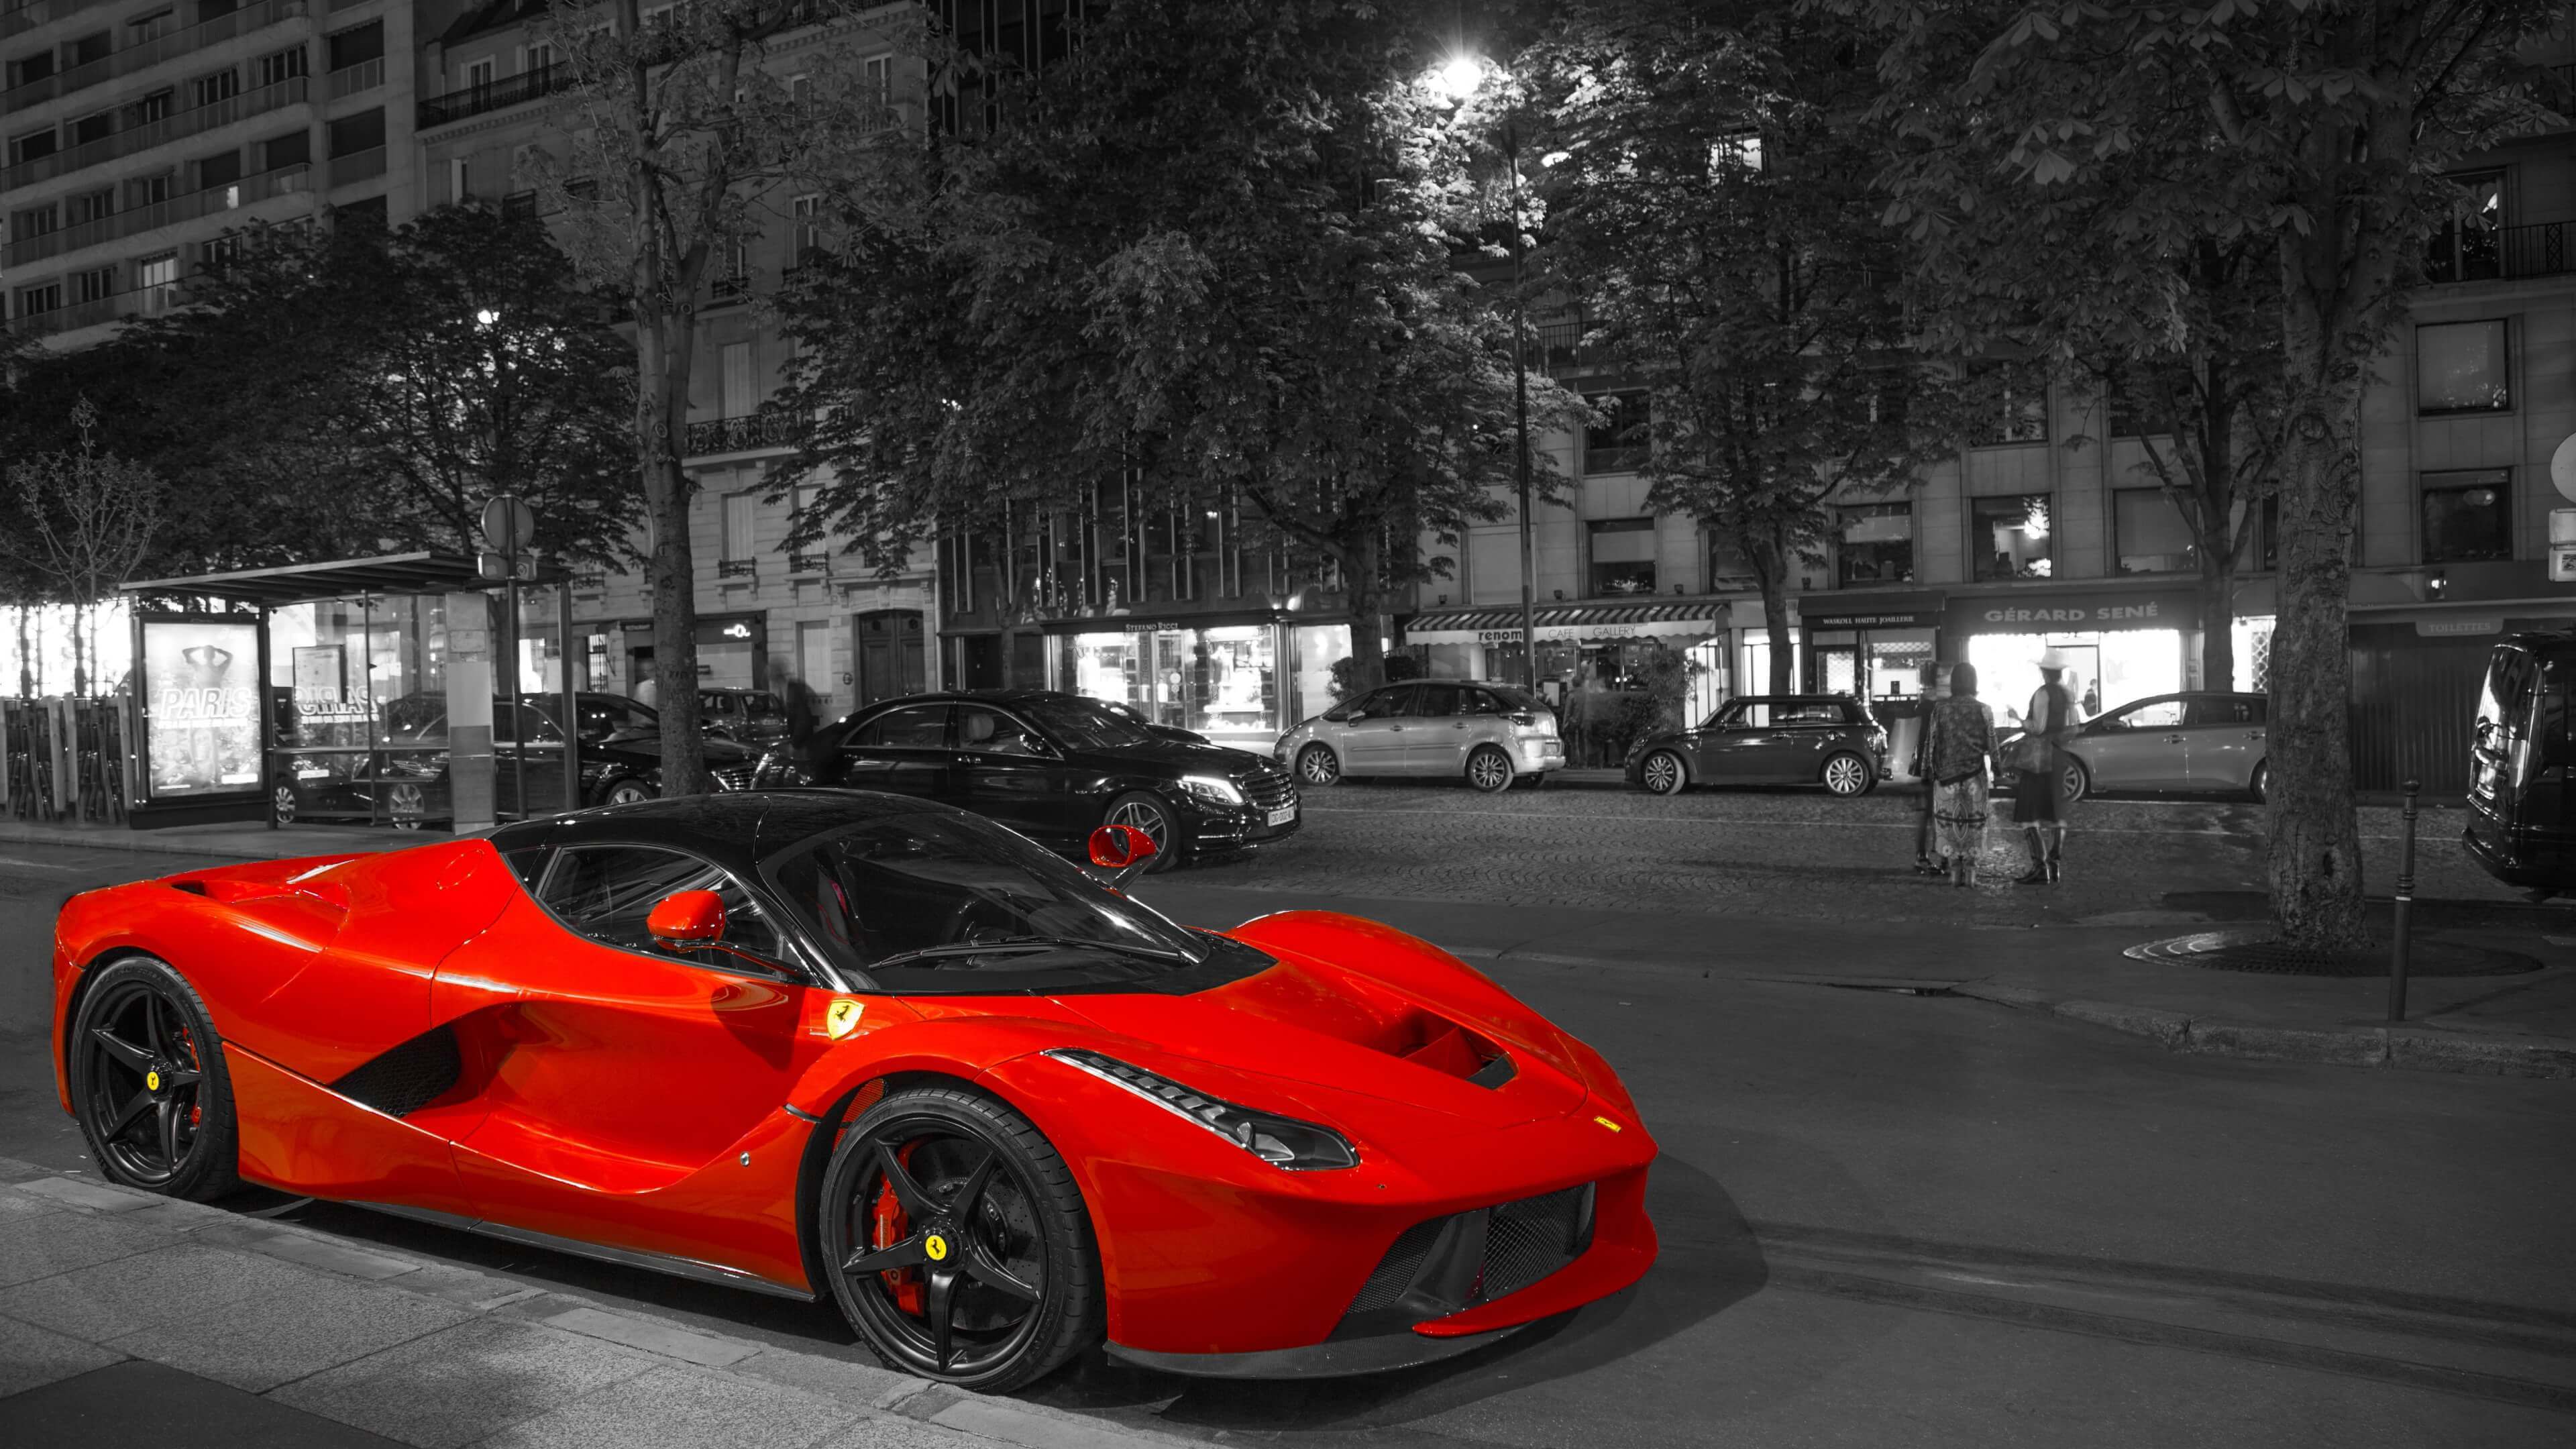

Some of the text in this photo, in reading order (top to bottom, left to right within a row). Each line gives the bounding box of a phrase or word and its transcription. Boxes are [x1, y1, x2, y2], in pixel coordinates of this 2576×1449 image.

[1984, 601, 2158, 622] GÉRARD SENÉ
[1593, 625, 1636, 637] GALLERY
[2428, 622, 2491, 633] TOILETTES
[159, 686, 252, 720] PARIS
